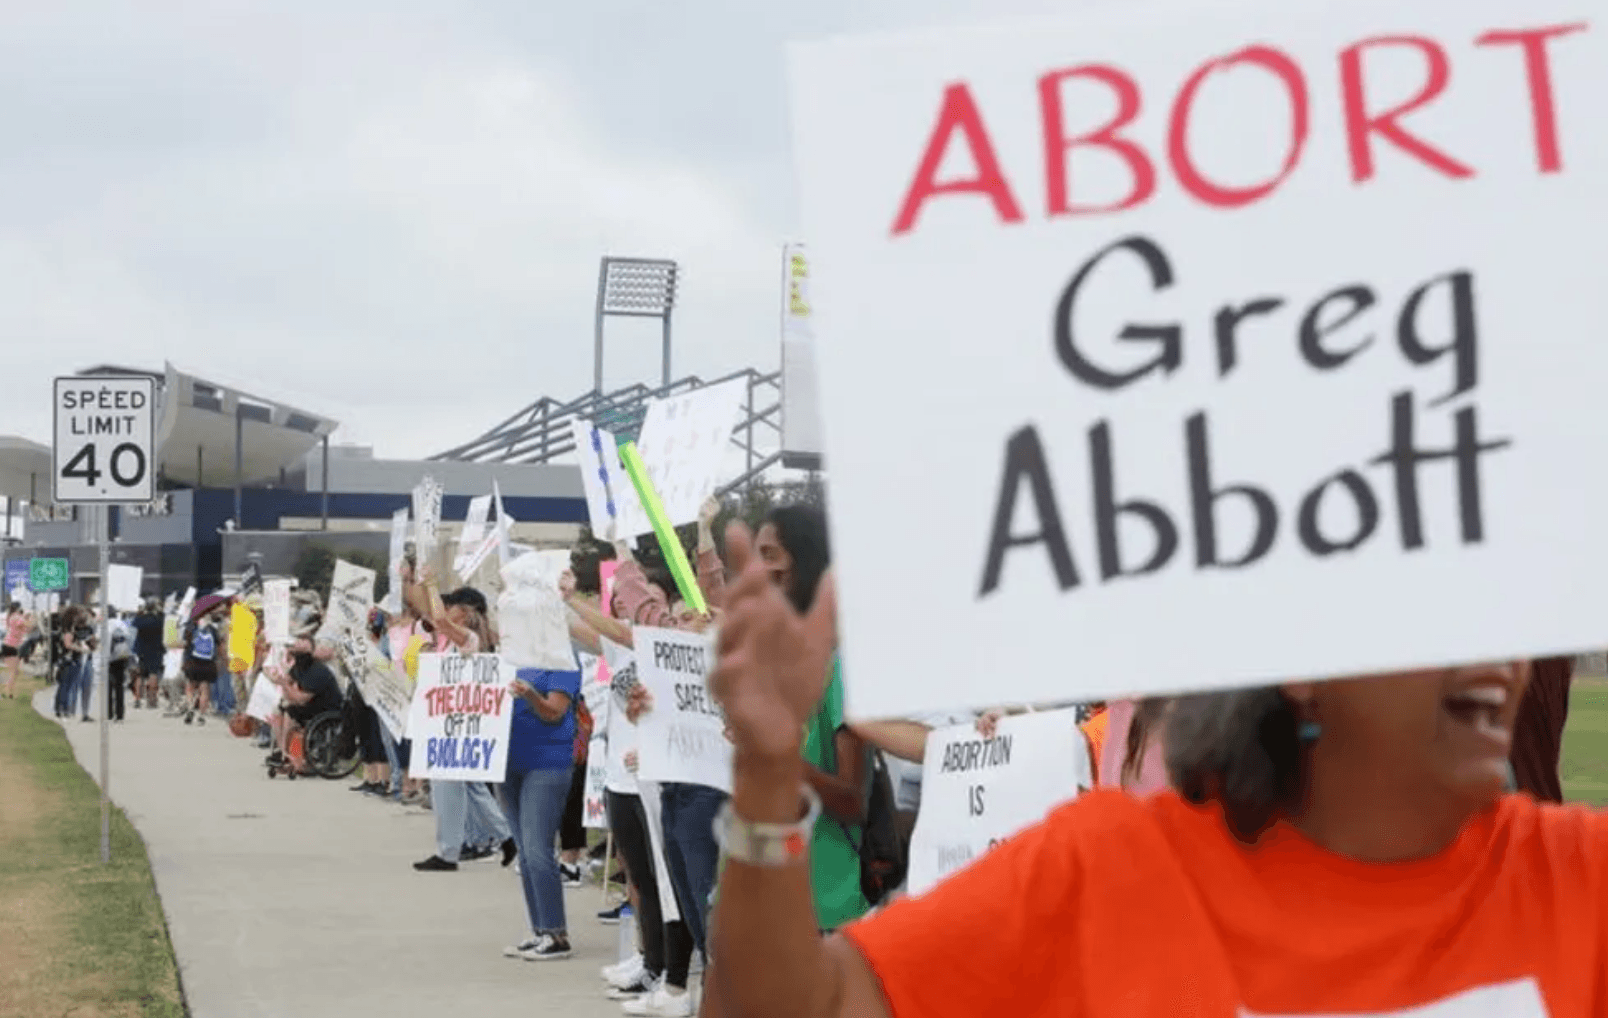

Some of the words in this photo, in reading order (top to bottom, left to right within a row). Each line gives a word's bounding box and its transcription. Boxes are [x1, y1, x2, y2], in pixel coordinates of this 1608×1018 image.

[890, 23, 1586, 237] ABORT
[1053, 236, 1480, 408] Greg
[63, 390, 146, 409] SPEED
[71, 415, 136, 435] LIMIT
[61, 442, 146, 487] 40
[978, 391, 1511, 598] Abbott
[440, 656, 467, 685] KEEP
[471, 656, 500, 685] YOUR
[425, 684, 506, 717] THEOLOGY
[444, 714, 464, 736] OFF
[465, 714, 481, 736] MY
[427, 737, 496, 770] BIOLOGY
[941, 734, 1013, 774] ABORTION
[969, 784, 985, 817] IS
